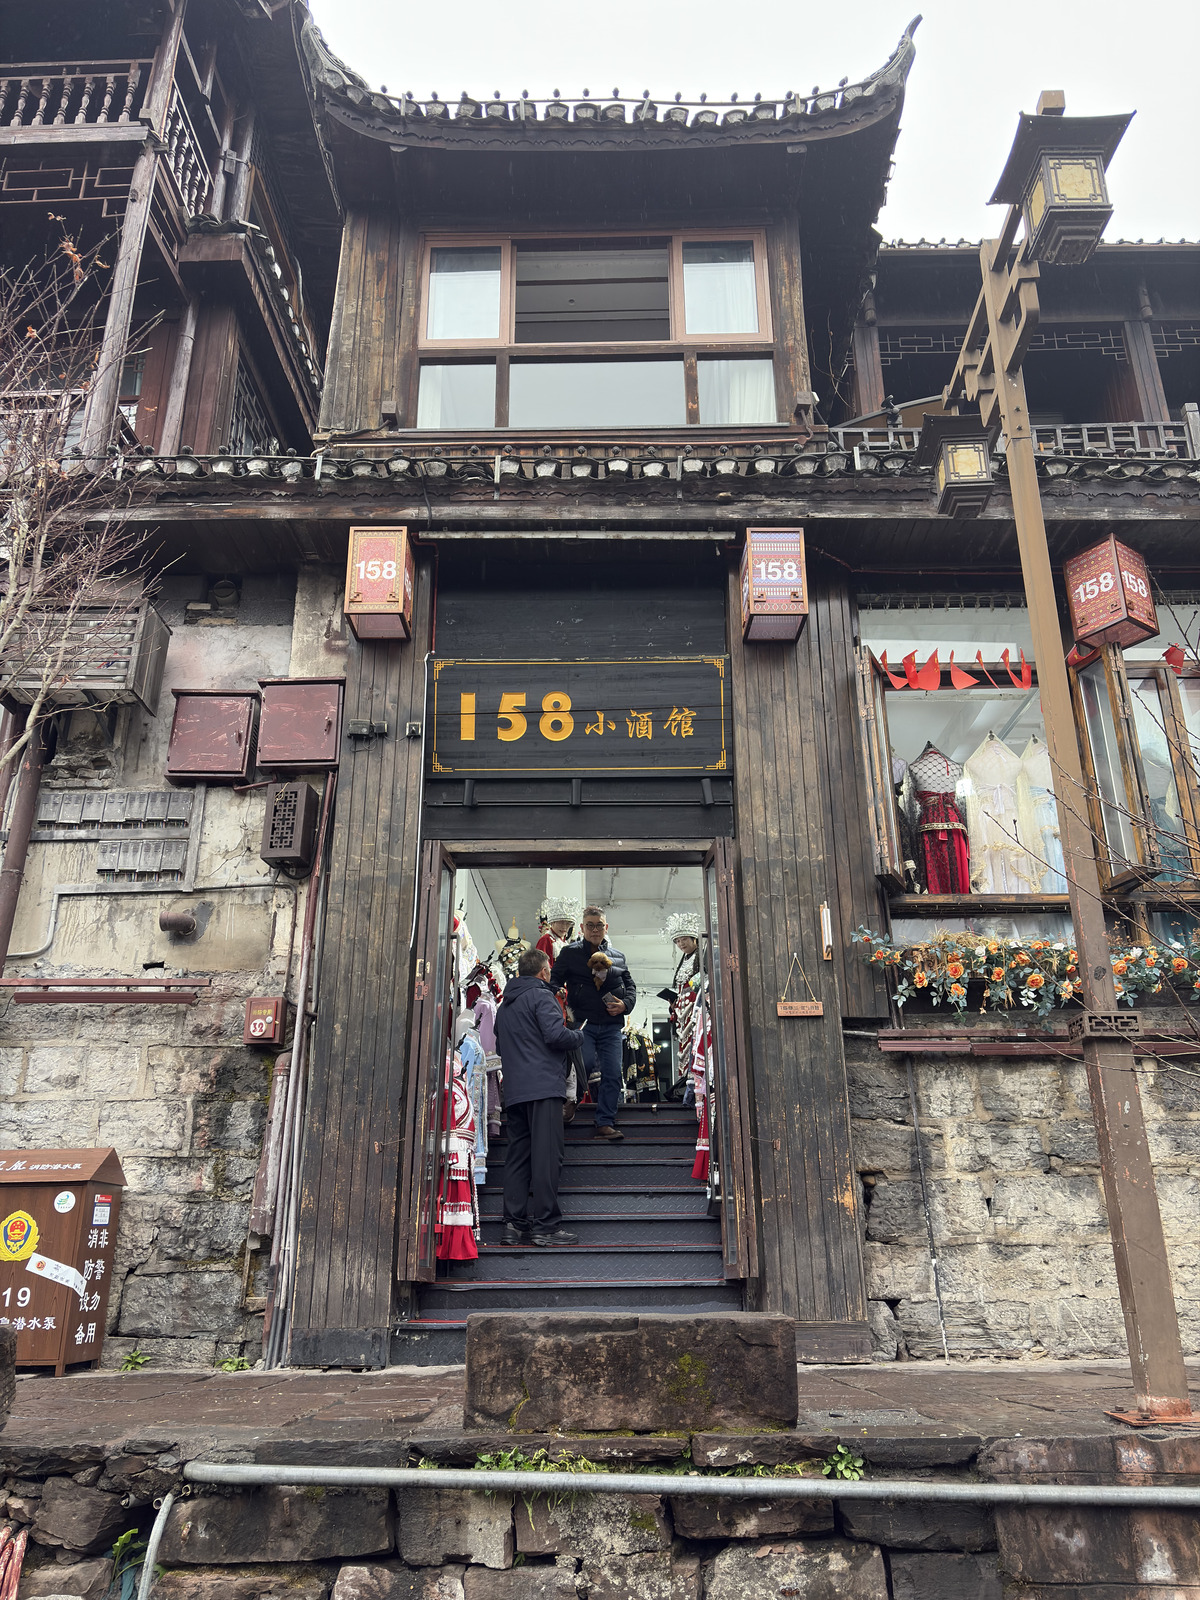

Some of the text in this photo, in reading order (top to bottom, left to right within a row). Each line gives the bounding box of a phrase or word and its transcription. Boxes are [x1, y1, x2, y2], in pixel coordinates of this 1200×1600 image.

[355, 560, 397, 580] 158
[755, 561, 799, 581] 158
[1074, 572, 1114, 603] 158
[1122, 570, 1148, 598] 158
